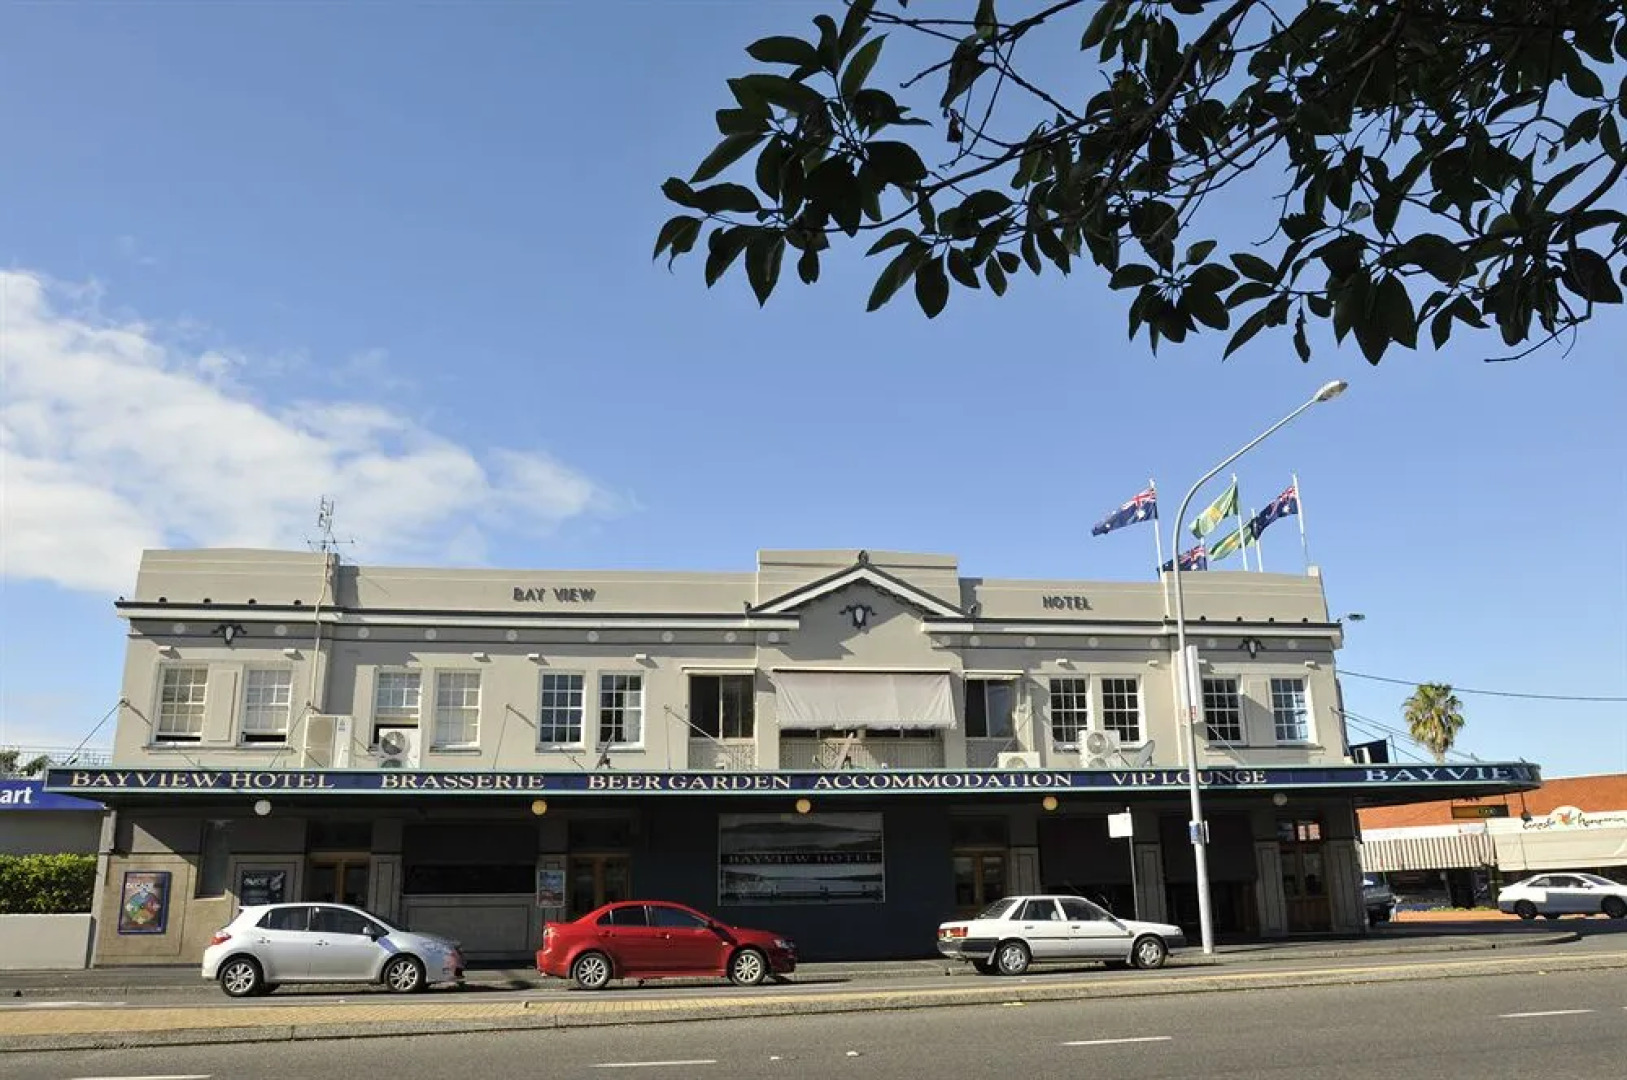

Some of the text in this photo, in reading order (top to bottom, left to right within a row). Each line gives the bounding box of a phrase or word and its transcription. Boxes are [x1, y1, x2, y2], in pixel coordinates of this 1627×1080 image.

[513, 587, 597, 602] BAY VIEW
[1042, 595, 1092, 609] HOTEL
[71, 770, 1268, 790] BAYVIEW HOTEL BRASSERIE BEER GARDEN ACCOMMODATION VIP LOUNGE
[0, 786, 33, 804] art
[728, 852, 875, 864] BAYVIEW HOTEL
